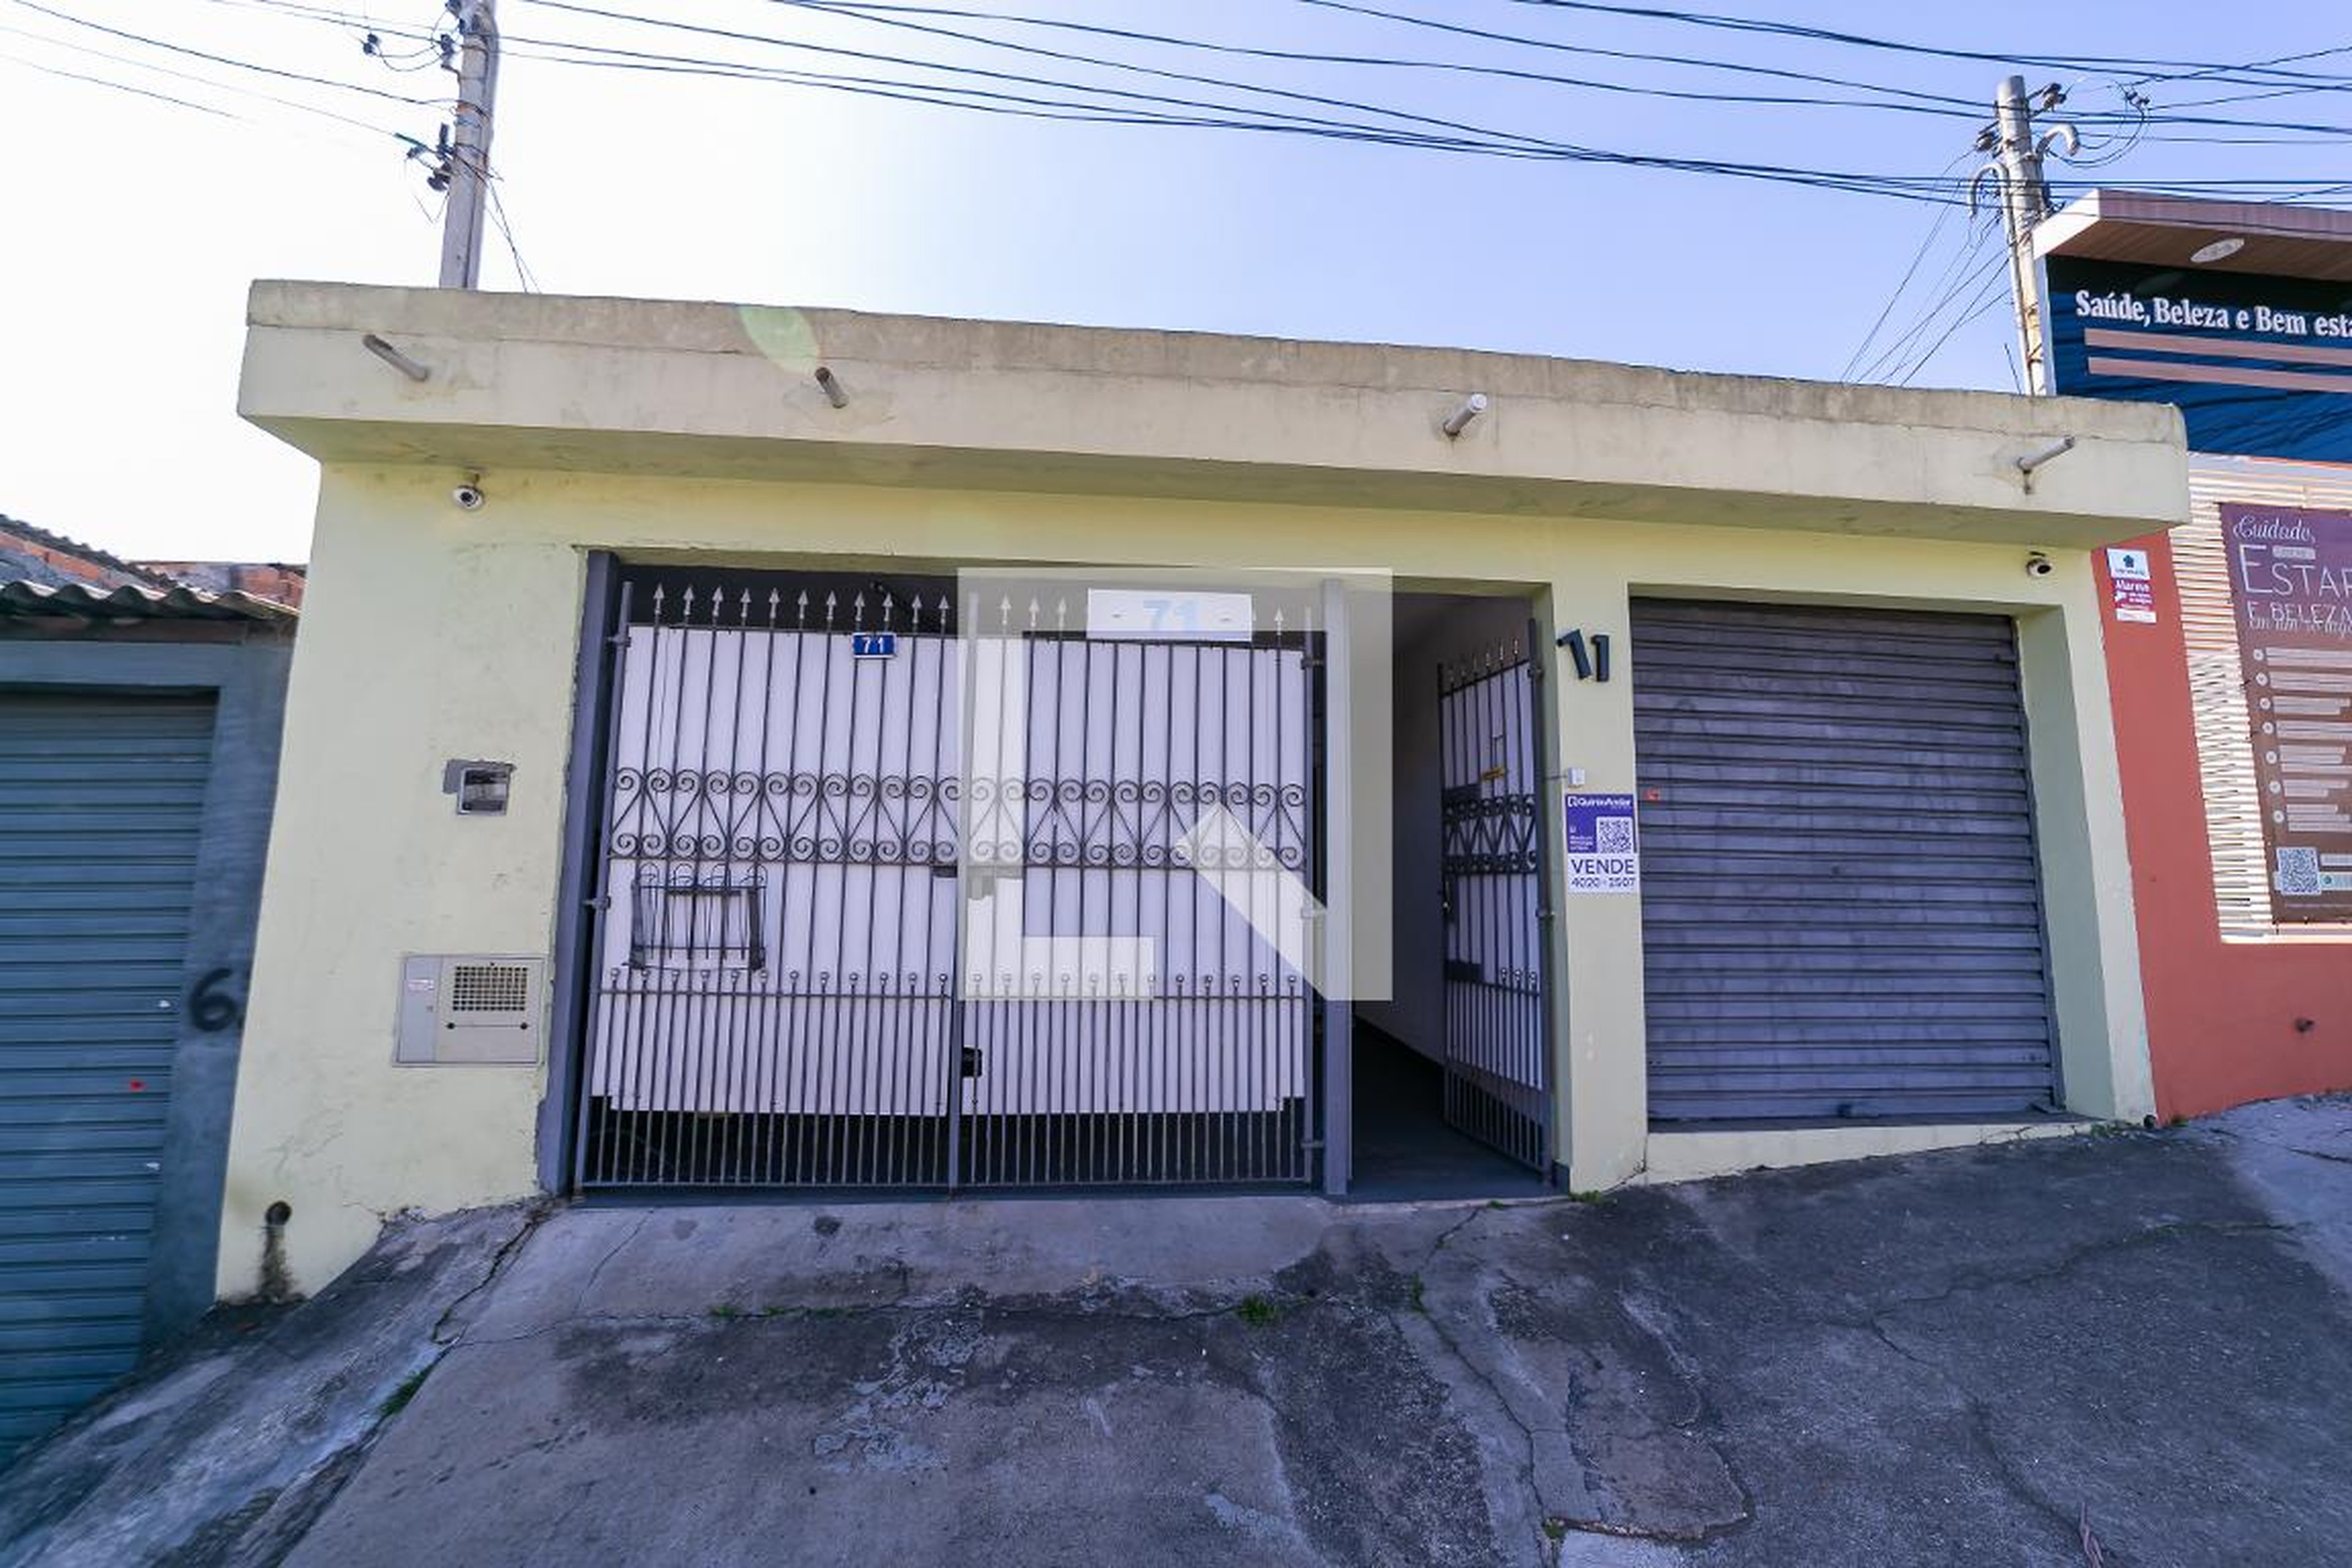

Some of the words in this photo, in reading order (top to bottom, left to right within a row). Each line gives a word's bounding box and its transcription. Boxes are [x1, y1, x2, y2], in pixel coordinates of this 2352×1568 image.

[2076, 289, 2150, 328] Saúde,
[2154, 297, 2229, 329] Beleza
[2236, 309, 2250, 330] e
[2255, 306, 2307, 335] Bem
[2233, 515, 2316, 543] Cuidado,
[1143, 599, 1202, 632] 71
[862, 637, 883, 654] 71
[1556, 629, 1609, 682] 71
[1571, 859, 1635, 875] VENDE
